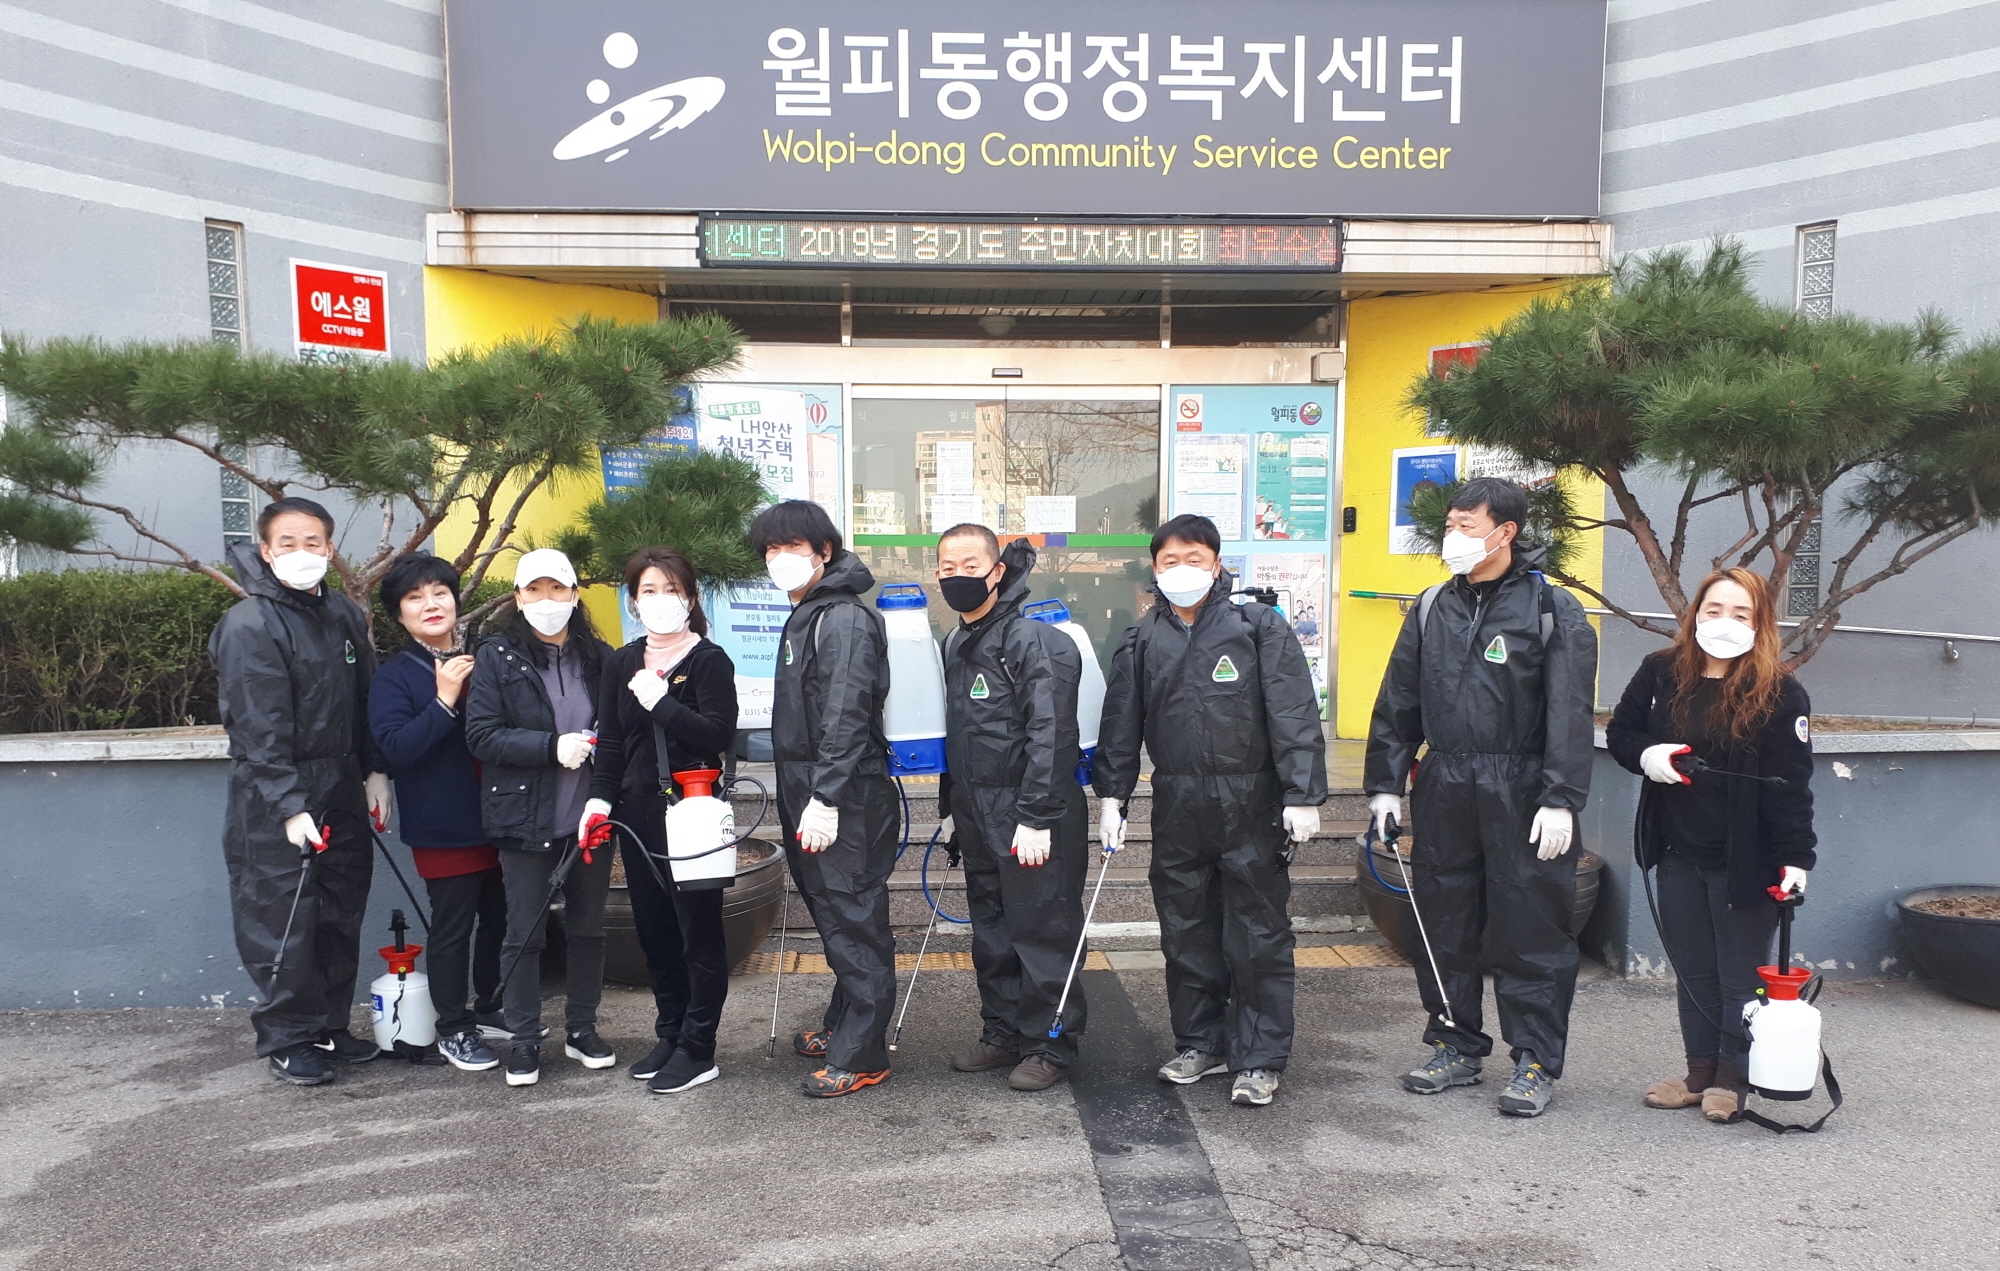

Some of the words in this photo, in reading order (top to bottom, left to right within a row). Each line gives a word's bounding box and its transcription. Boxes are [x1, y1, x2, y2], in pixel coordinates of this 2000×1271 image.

[763, 27, 1463, 124] 월피동행정복지센터
[763, 128, 966, 174] Wolpi-dong
[980, 131, 1178, 176] Community
[1192, 134, 1319, 169] Service
[1332, 135, 1452, 170] Center
[800, 225, 897, 260] 2019년
[911, 225, 1006, 261] 경기도
[1018, 226, 1204, 262] 주민자치대회
[310, 291, 371, 323] 에스원
[321, 323, 343, 335] CCTV
[1270, 407, 1297, 423] 월피동
[741, 419, 793, 439] LH안산
[717, 435, 793, 462] 청년주택
[766, 465, 794, 483] 모집
